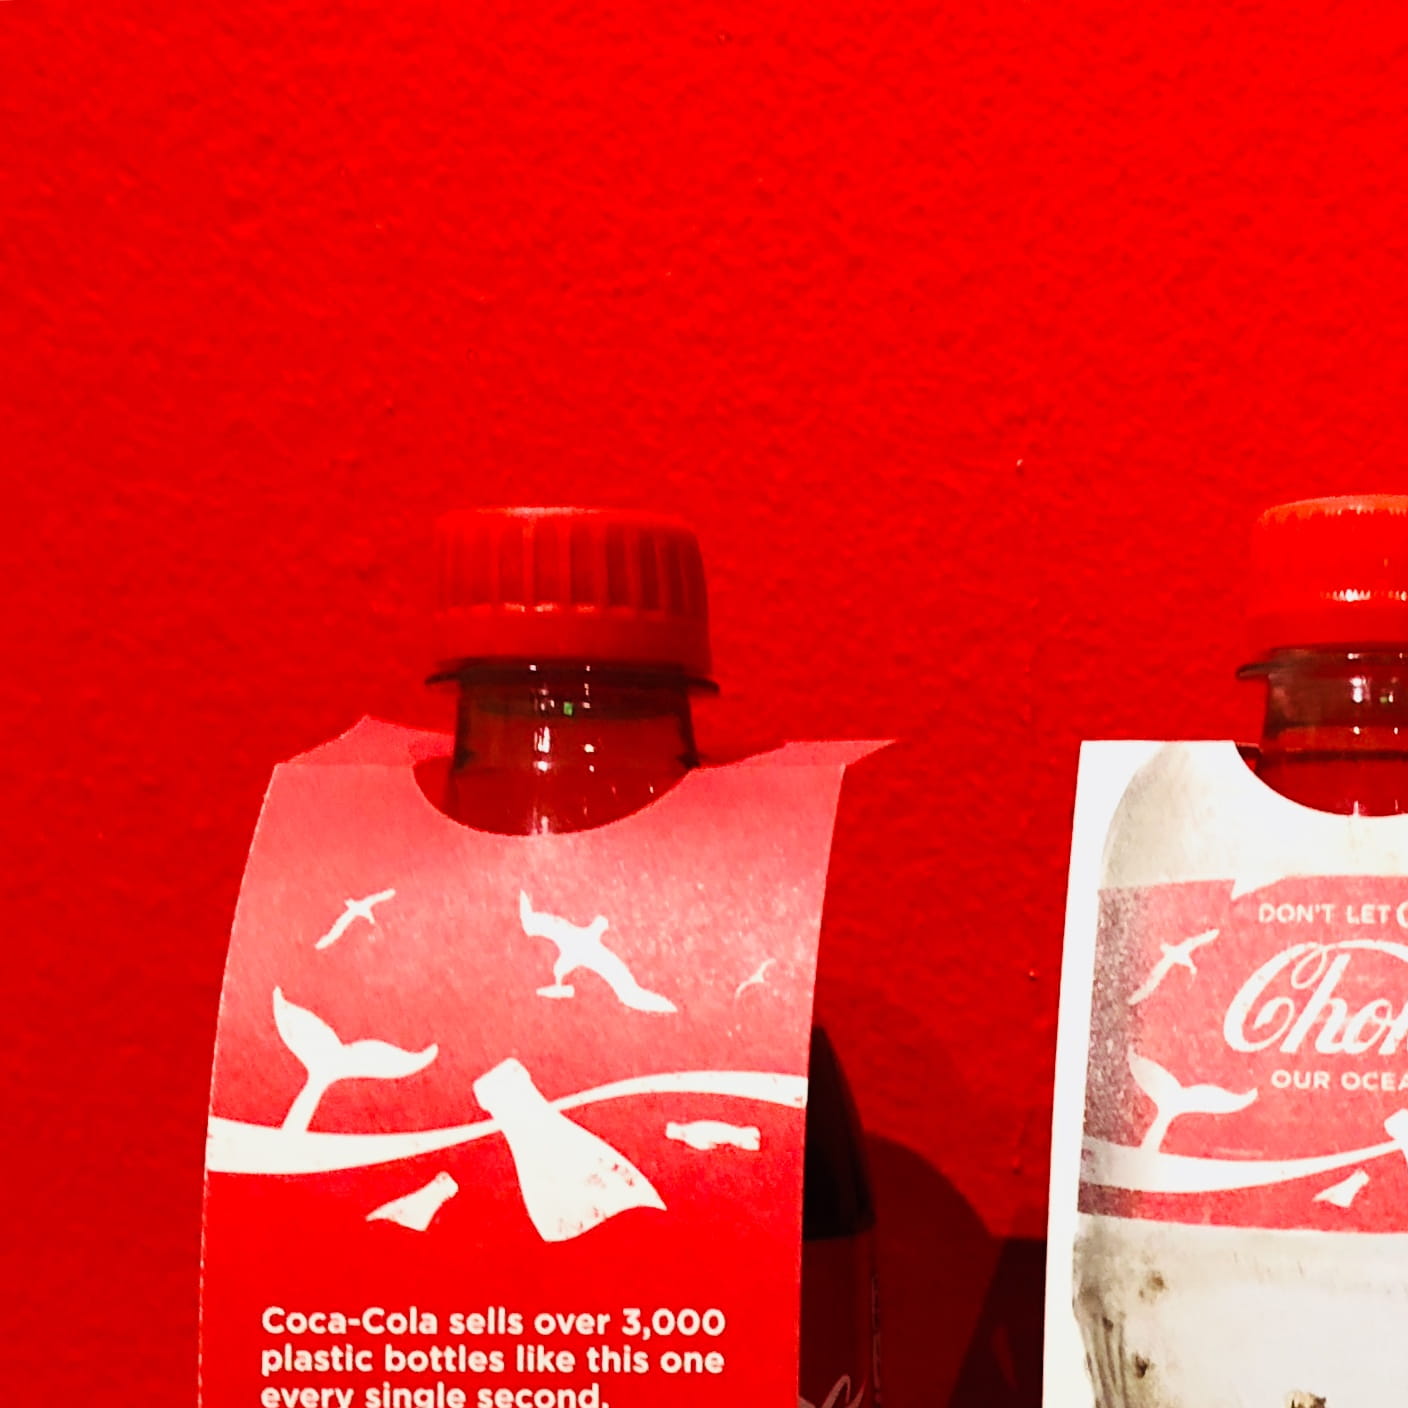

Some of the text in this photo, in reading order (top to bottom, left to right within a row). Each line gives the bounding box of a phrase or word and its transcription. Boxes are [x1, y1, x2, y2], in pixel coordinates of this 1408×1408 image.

[1258, 902, 1337, 924] DON'T
[1345, 903, 1391, 925] LET
[1270, 1069, 1331, 1090] OUR
[261, 1305, 726, 1341] Coca-Cola sells over 3,000
[261, 1342, 725, 1377] plastic bottles like this one
